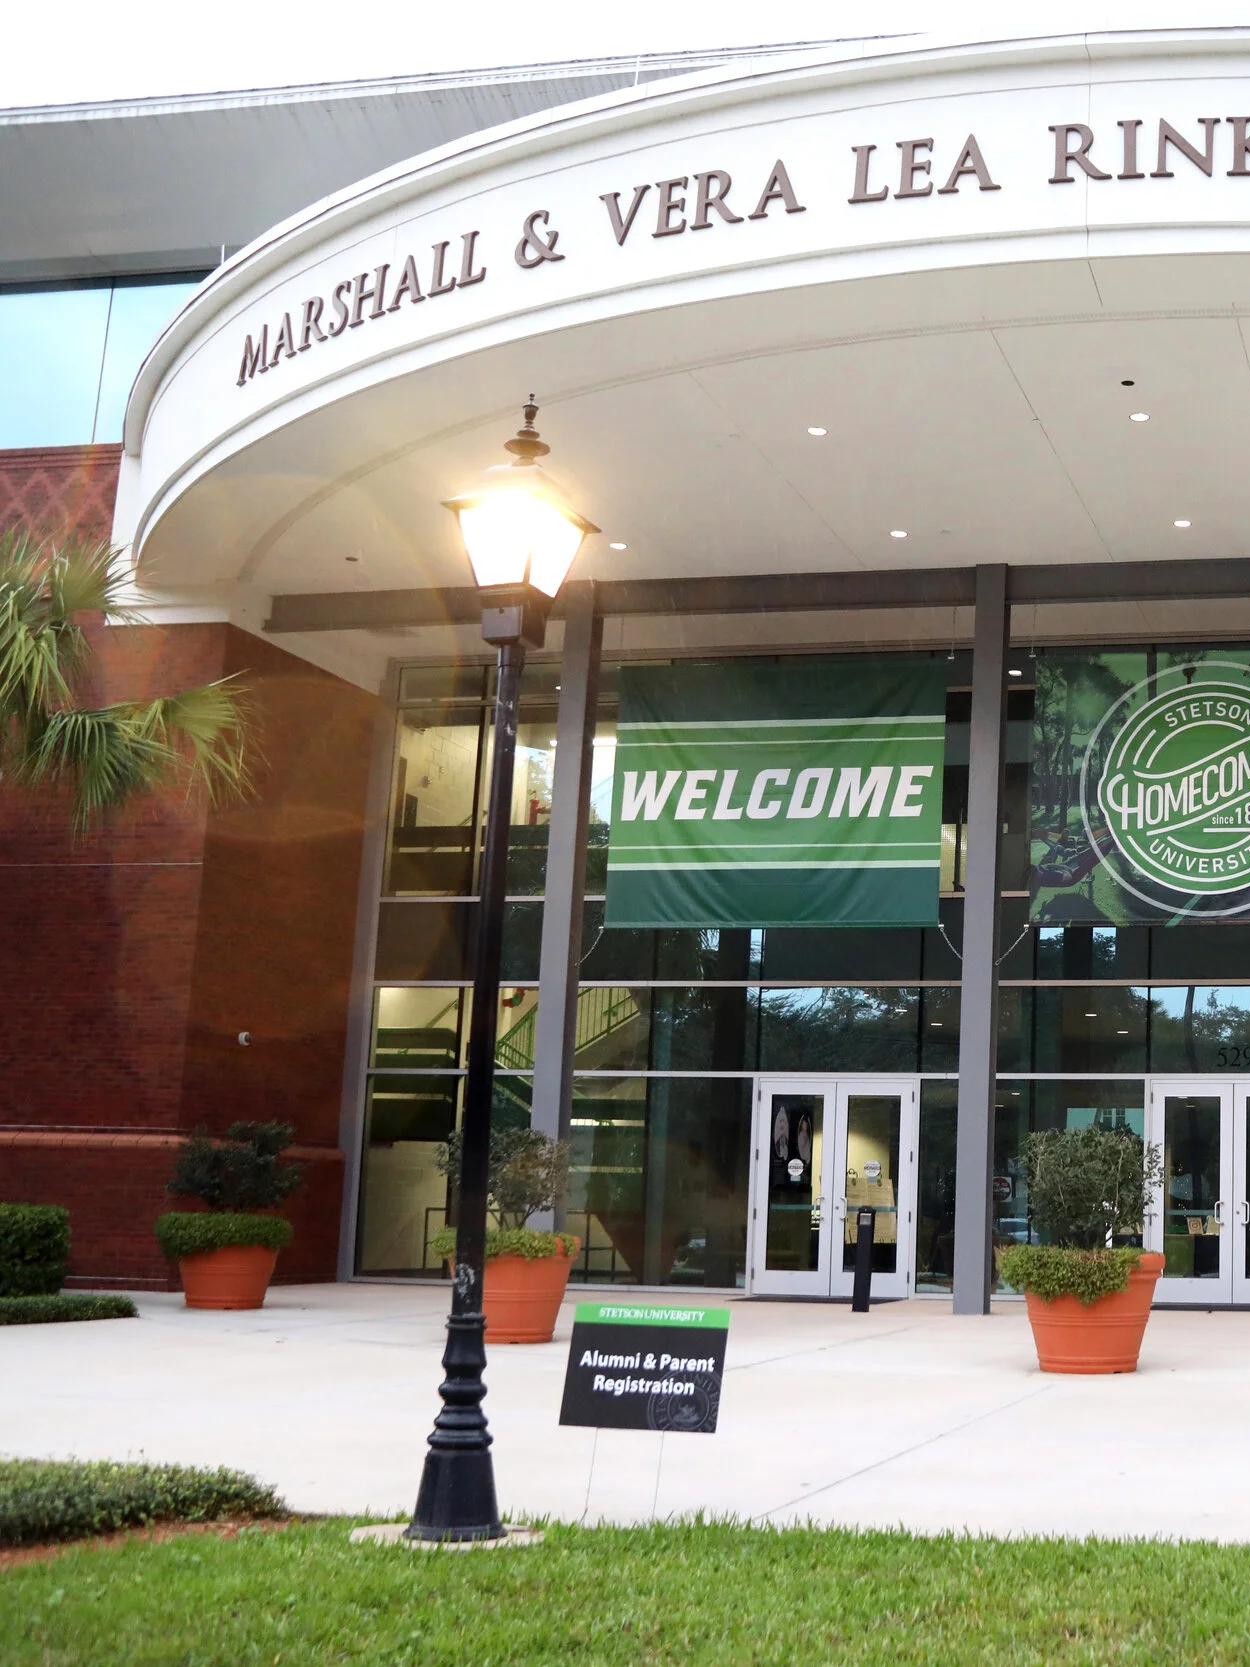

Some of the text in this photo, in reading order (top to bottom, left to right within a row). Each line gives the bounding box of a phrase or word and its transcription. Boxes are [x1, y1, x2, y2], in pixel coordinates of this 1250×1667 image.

[235, 230, 487, 387] MARSHALL
[514, 209, 567, 269] &
[599, 159, 807, 247] VERA
[847, 133, 1002, 205] LEA
[620, 765, 934, 822] WELCOME
[1211, 814, 1234, 825] since
[599, 1306, 705, 1322] STETSON UNIVERSITY
[579, 1350, 716, 1373] Alumni & Parent
[593, 1375, 696, 1396] Registration
